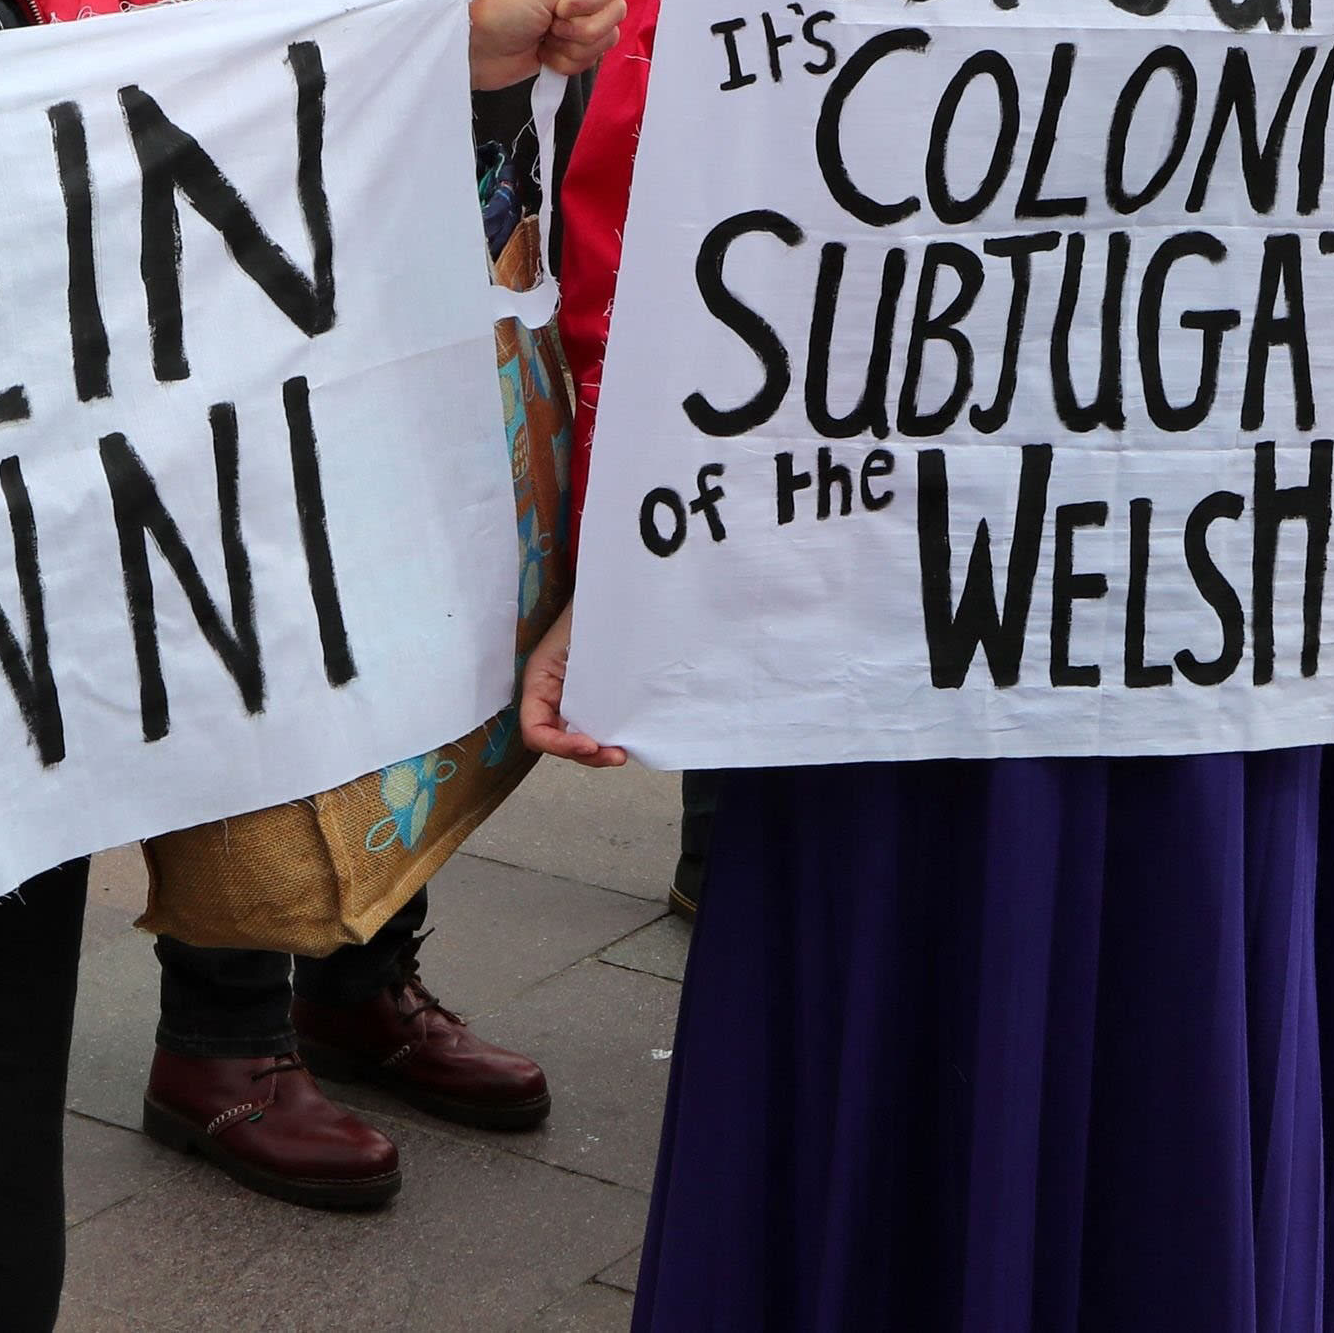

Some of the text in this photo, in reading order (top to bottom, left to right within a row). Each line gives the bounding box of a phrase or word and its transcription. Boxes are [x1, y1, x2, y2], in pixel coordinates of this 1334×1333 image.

[99, 375, 358, 744] NI
[639, 463, 726, 558] of
[774, 447, 895, 526] the
[917, 440, 1334, 690] WELSH
